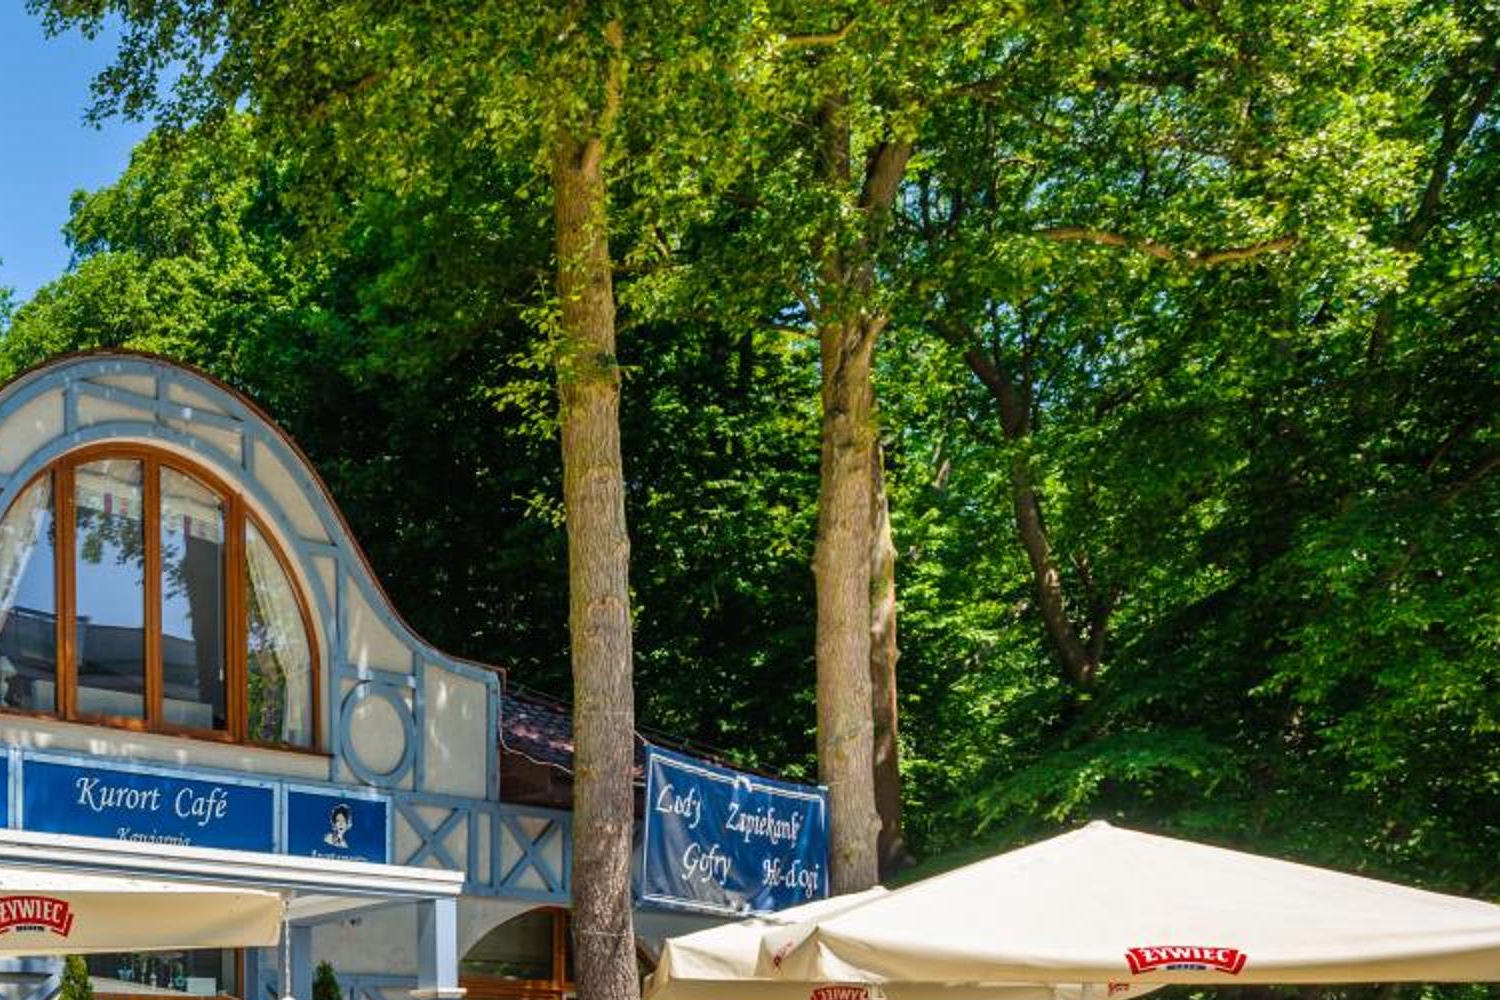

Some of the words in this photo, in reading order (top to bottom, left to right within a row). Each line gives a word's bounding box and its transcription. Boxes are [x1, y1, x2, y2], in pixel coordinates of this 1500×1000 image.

[76, 777, 161, 812] Kurort
[175, 787, 228, 826] Café
[655, 784, 700, 829] Lody
[681, 842, 731, 884] Gofry
[1138, 947, 1229, 963] ŻYWIEC
